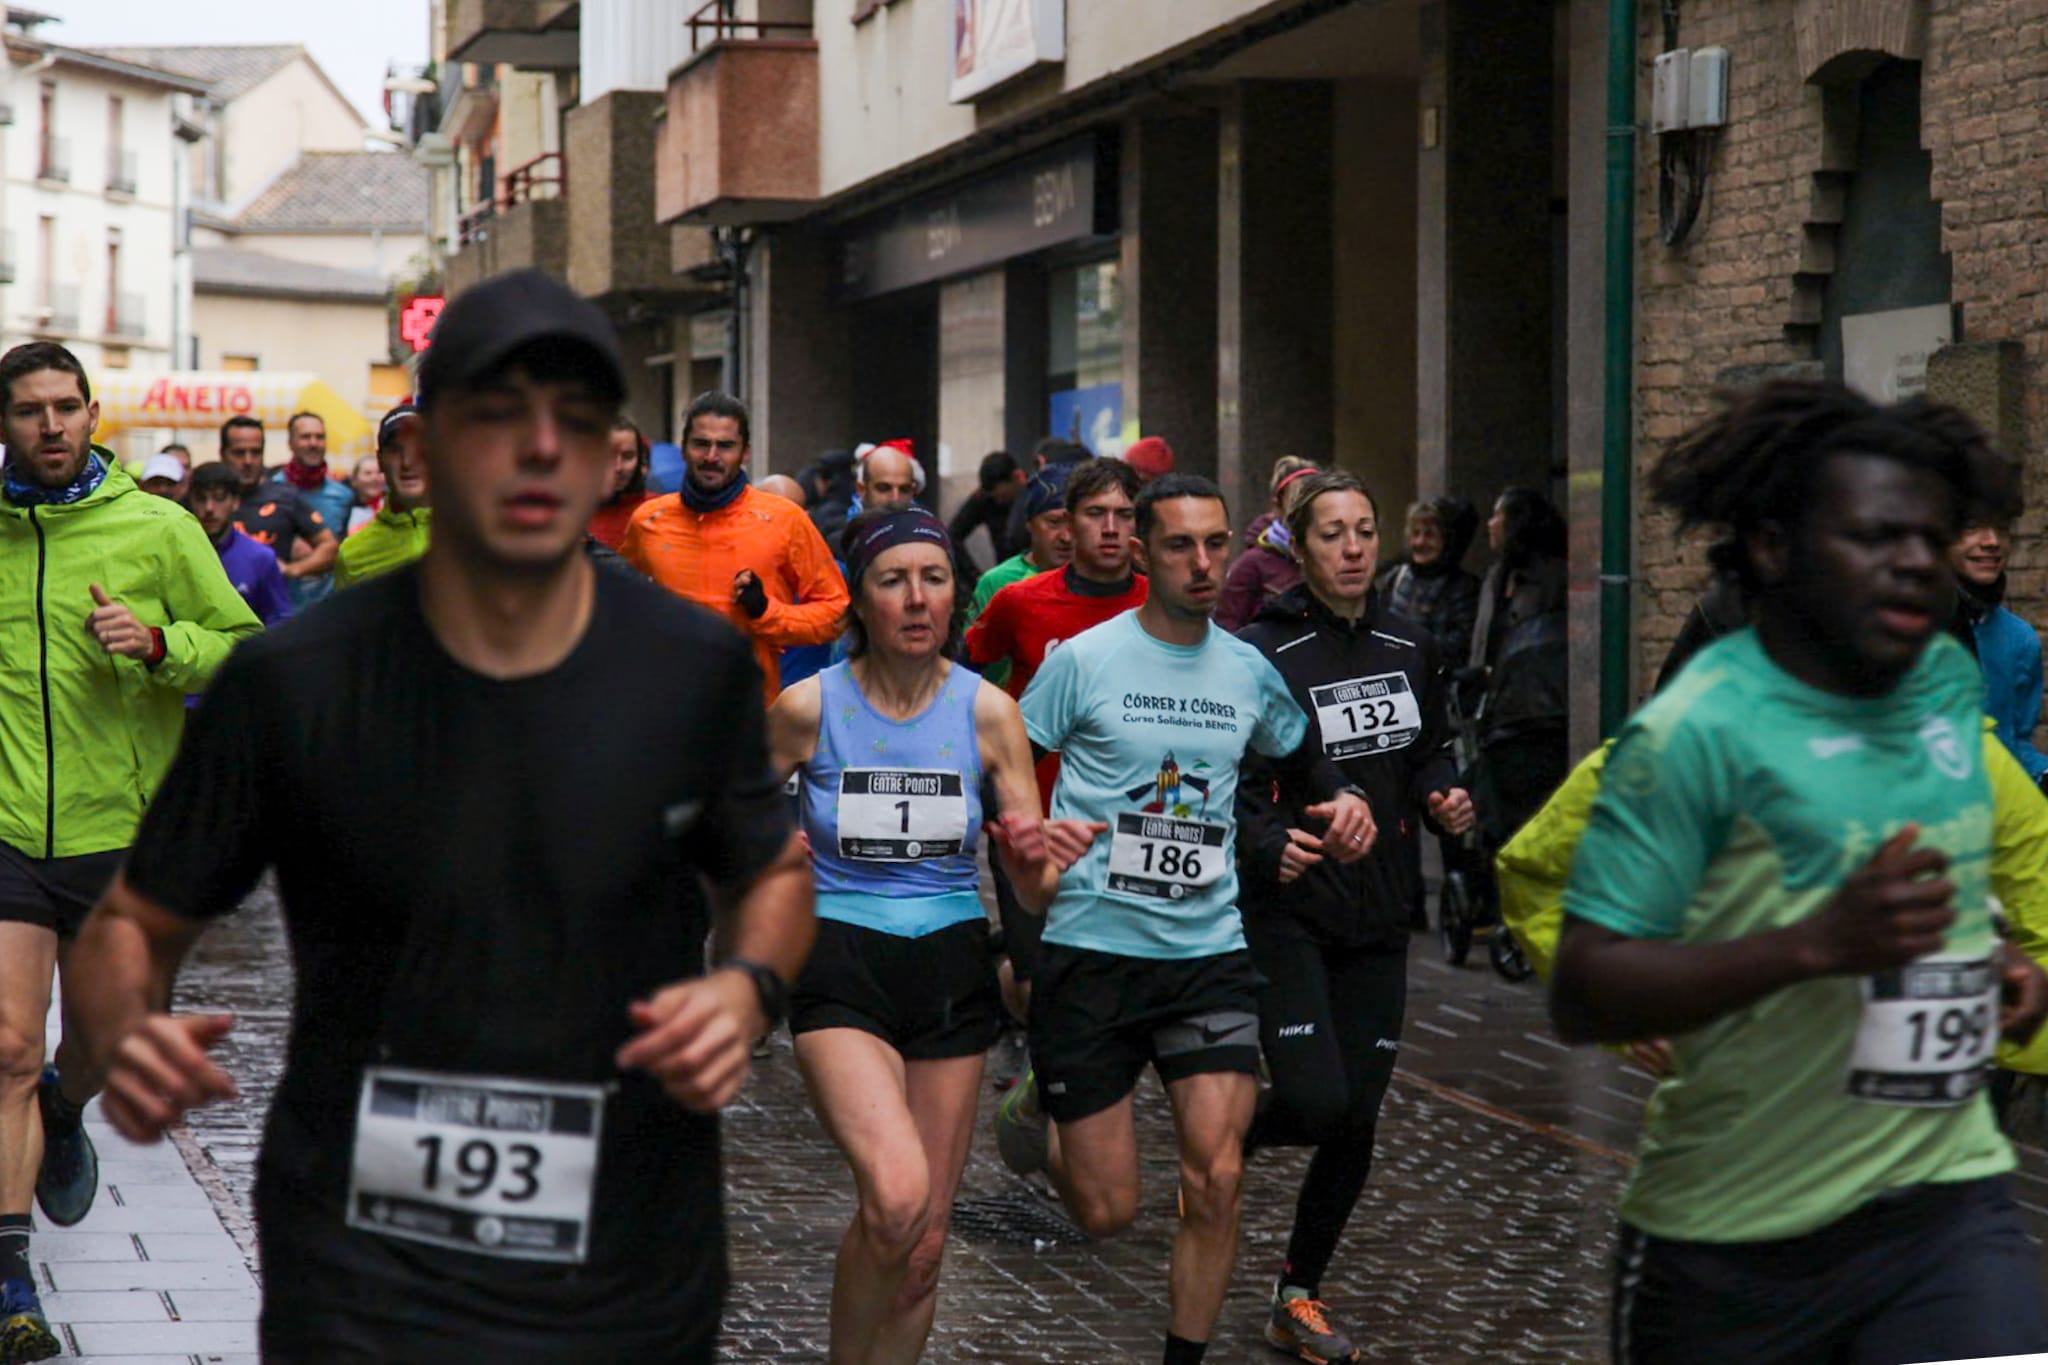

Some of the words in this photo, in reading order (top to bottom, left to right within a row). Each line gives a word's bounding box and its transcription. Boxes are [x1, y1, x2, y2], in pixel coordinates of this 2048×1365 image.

[1123, 692, 1176, 711] CÓRRER
[1191, 698, 1237, 719] CÓRRER
[1342, 700, 1399, 733] 132
[1157, 714, 1202, 728] Solidària
[1205, 720, 1238, 733] BENITO
[894, 800, 910, 833] 1
[1140, 842, 1202, 879] 186
[1278, 1022, 1315, 1038] NIKE
[415, 1134, 543, 1203] 193
